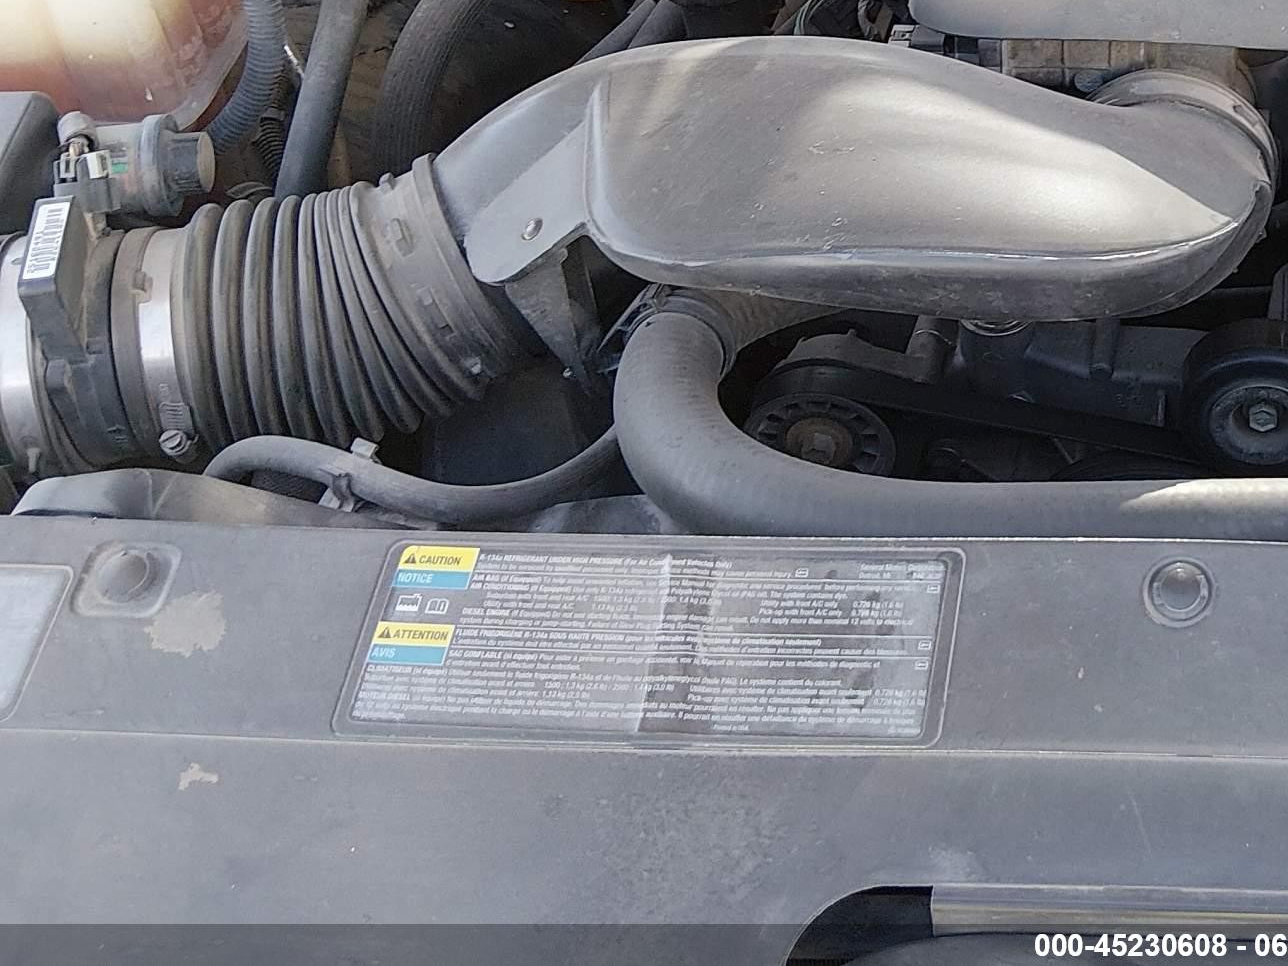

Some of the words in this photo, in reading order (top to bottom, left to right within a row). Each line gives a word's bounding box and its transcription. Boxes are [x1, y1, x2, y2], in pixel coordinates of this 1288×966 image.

[418, 555, 463, 566] CAUTION
[398, 572, 433, 583] NOTICE
[392, 629, 449, 641] ATTENTION
[371, 647, 396, 659] AVIS
